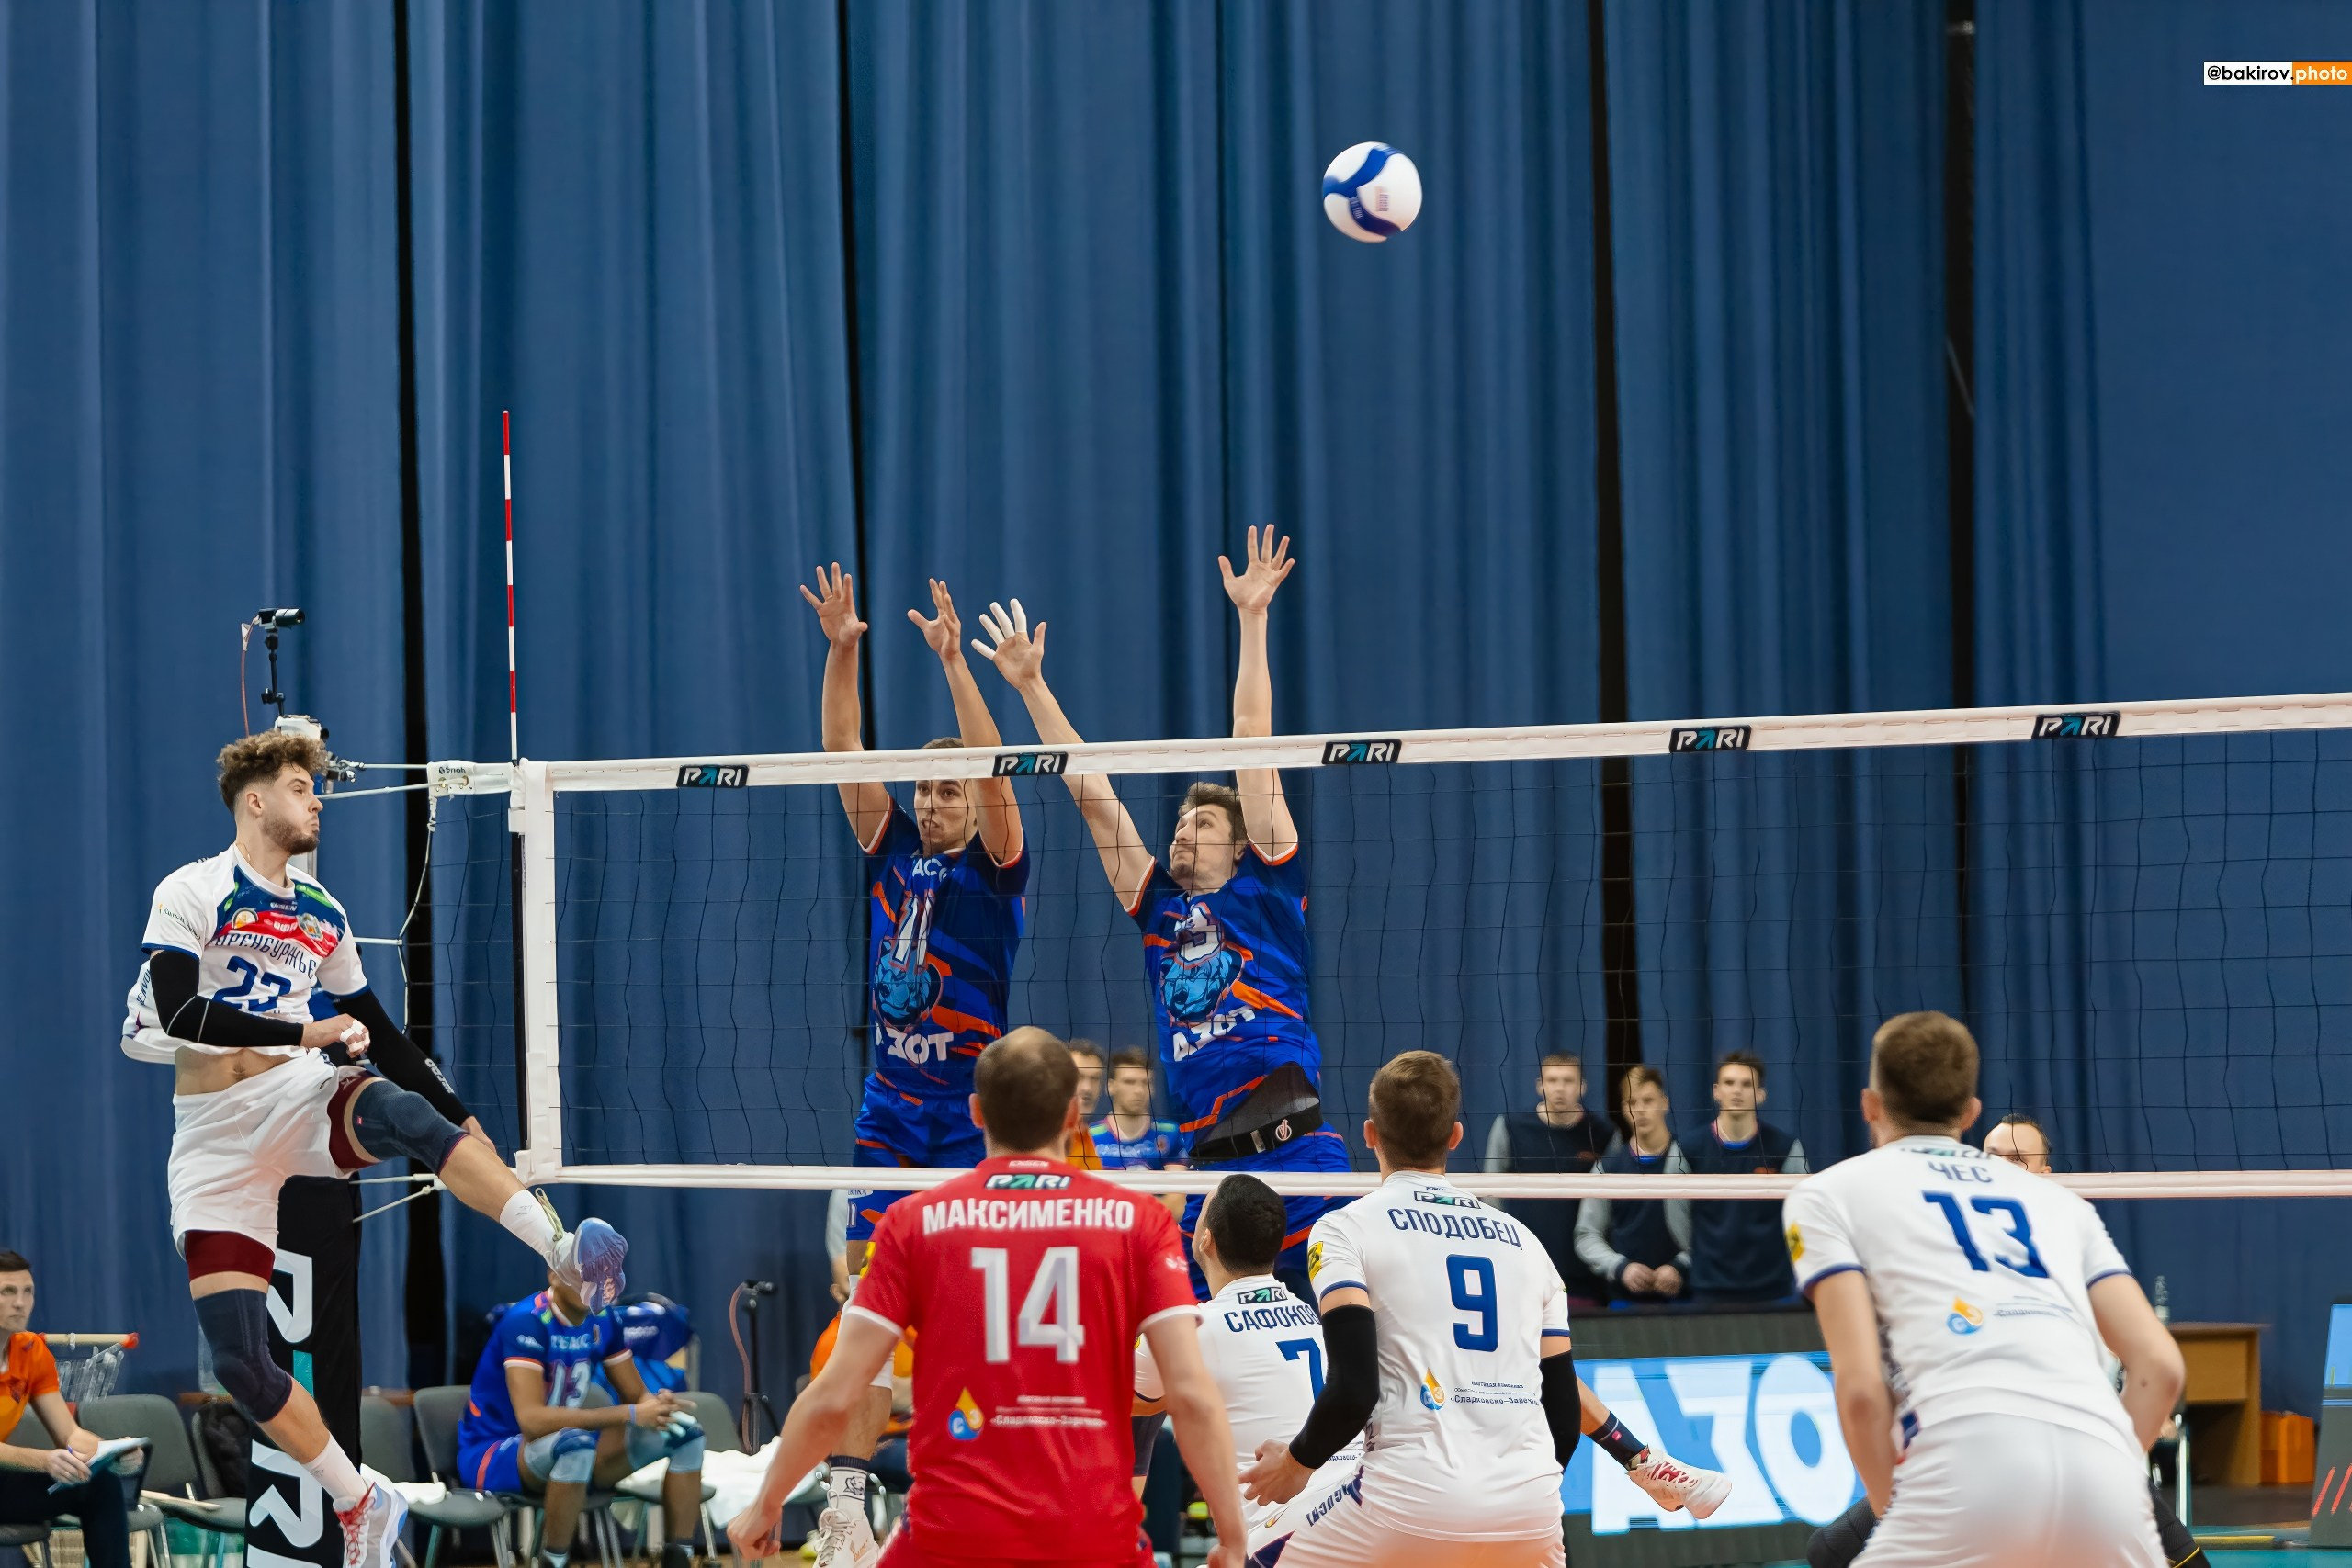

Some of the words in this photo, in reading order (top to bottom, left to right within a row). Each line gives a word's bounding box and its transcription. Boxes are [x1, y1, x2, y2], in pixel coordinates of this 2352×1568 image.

[1675, 728, 1746, 750] PARI
[2038, 715, 2112, 737] PARI
[997, 754, 1061, 774] PARI
[1328, 741, 1395, 763] PARI
[682, 766, 741, 787] PARI
[211, 955, 292, 1012] 23
[1172, 1004, 1256, 1063] АЗОТ
[985, 1175, 1070, 1190] PARI
[1928, 1159, 1993, 1183] ЧЕС
[922, 1198, 1136, 1235] МАКСИМЕНКО
[1387, 1208, 1523, 1251] СПОДОБЕЦ
[1921, 1190, 2050, 1279] 13
[971, 1247, 1086, 1363] 14
[1446, 1254, 1499, 1352] 9
[1275, 1337, 1325, 1403] 7
[1592, 1355, 1857, 1536] АЗО
